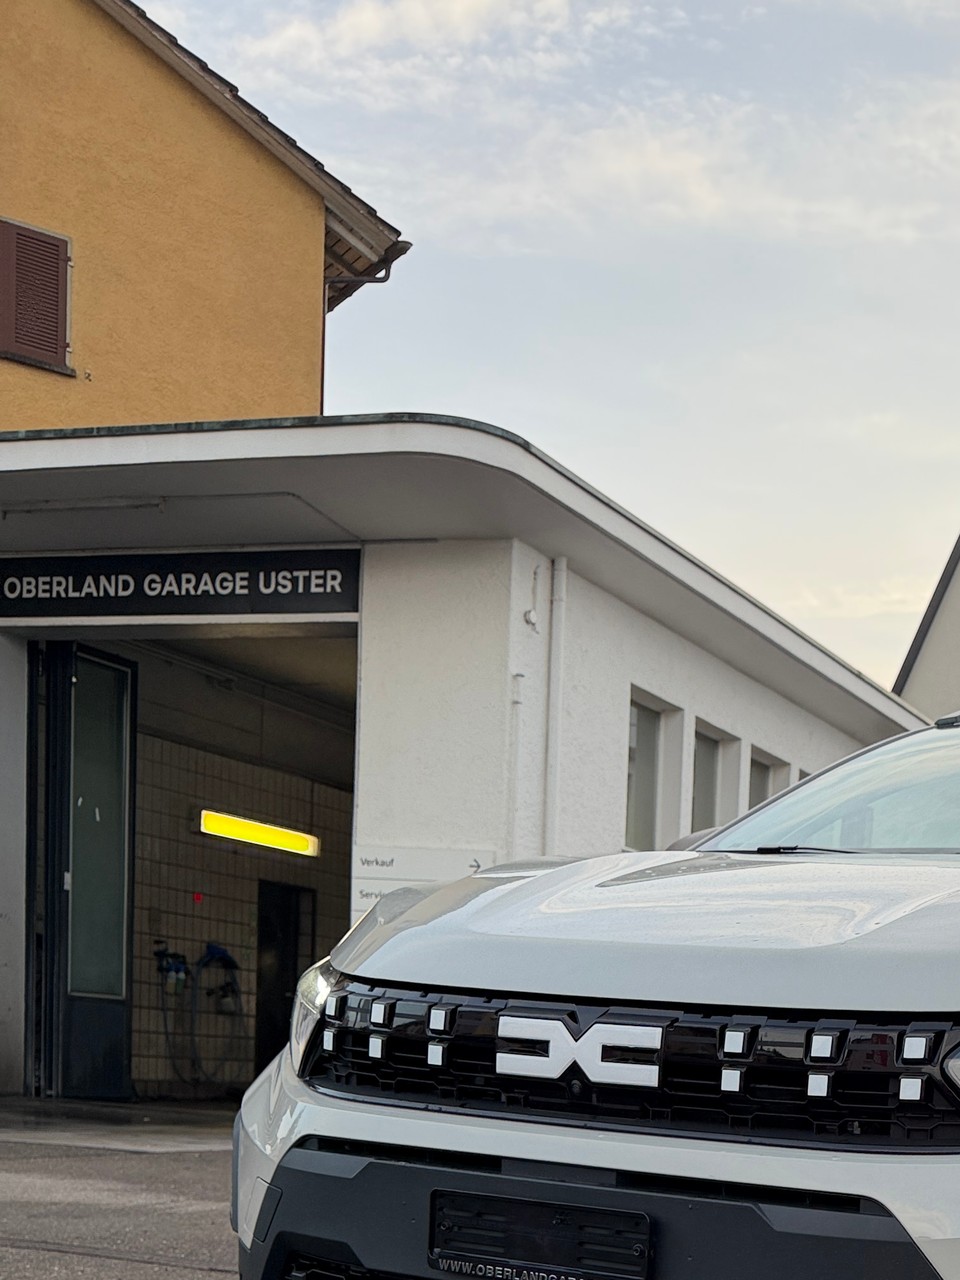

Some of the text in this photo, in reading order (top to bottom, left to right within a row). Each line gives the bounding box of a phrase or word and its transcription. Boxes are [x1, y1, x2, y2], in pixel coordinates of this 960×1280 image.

[4, 569, 342, 599] OBERLAND GARAGE USTER
[360, 856, 394, 868] Verkauf
